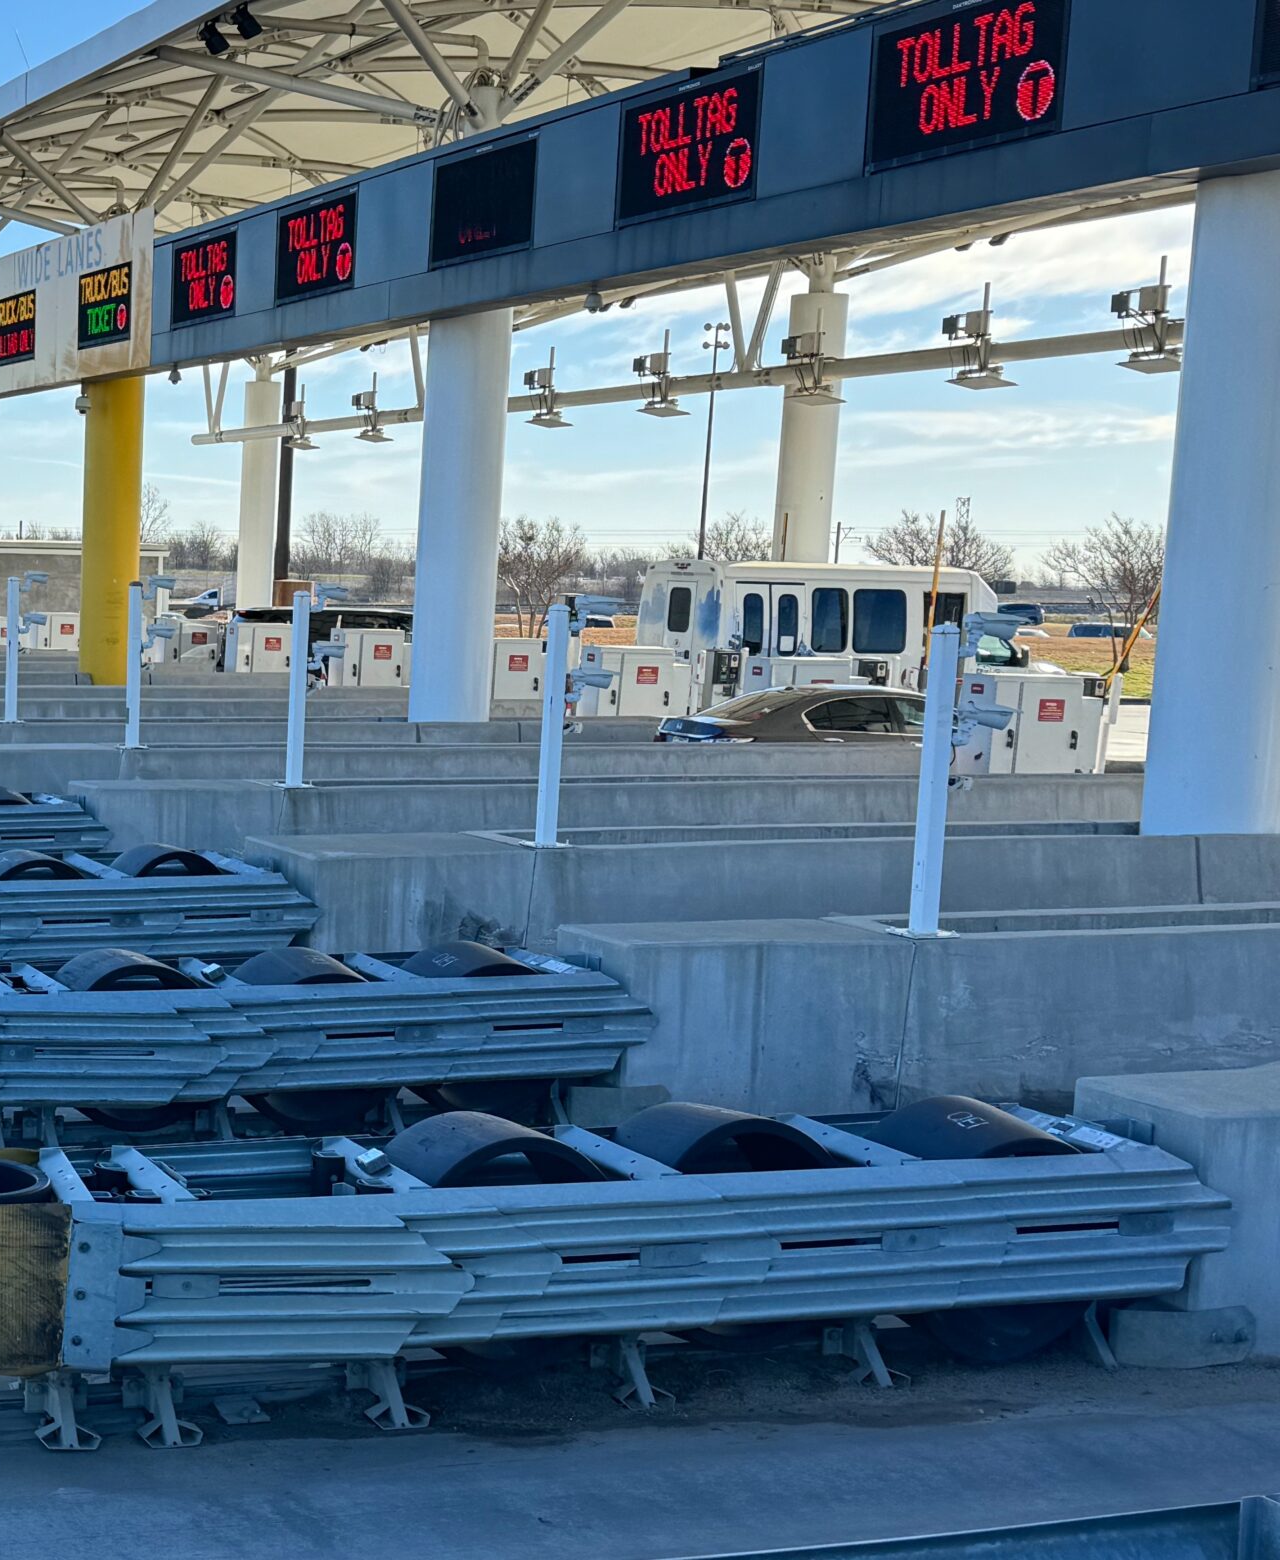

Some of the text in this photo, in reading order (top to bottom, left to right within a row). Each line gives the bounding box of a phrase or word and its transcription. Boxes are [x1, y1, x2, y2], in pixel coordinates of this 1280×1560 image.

[919, 67, 1001, 134] ONLY
[654, 141, 712, 197] ONLY
[17, 228, 103, 288] WIDE LANES
[297, 243, 331, 285] ONLY
[80, 266, 129, 305] TRUCK/BUS
[189, 275, 216, 311] ONLY
[87, 303, 116, 335] TICKET
